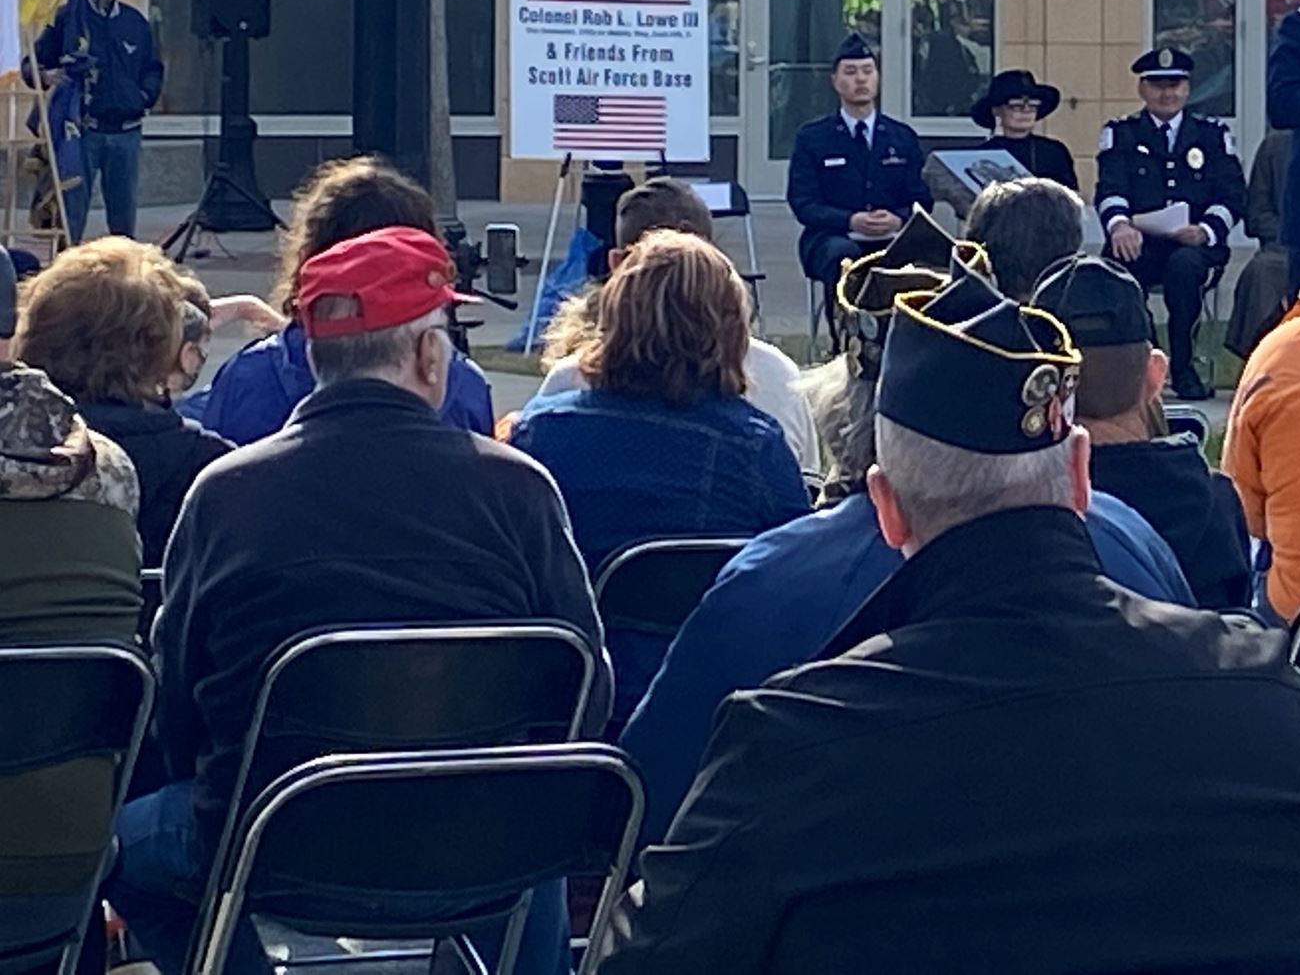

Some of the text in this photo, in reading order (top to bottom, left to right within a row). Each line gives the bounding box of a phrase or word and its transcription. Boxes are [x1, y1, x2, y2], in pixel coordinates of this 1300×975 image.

[519, 6, 699, 28] Colonel Rob L. Lowe III
[546, 42, 674, 63] & Friends From
[528, 66, 693, 89] Scott Air Force Base
